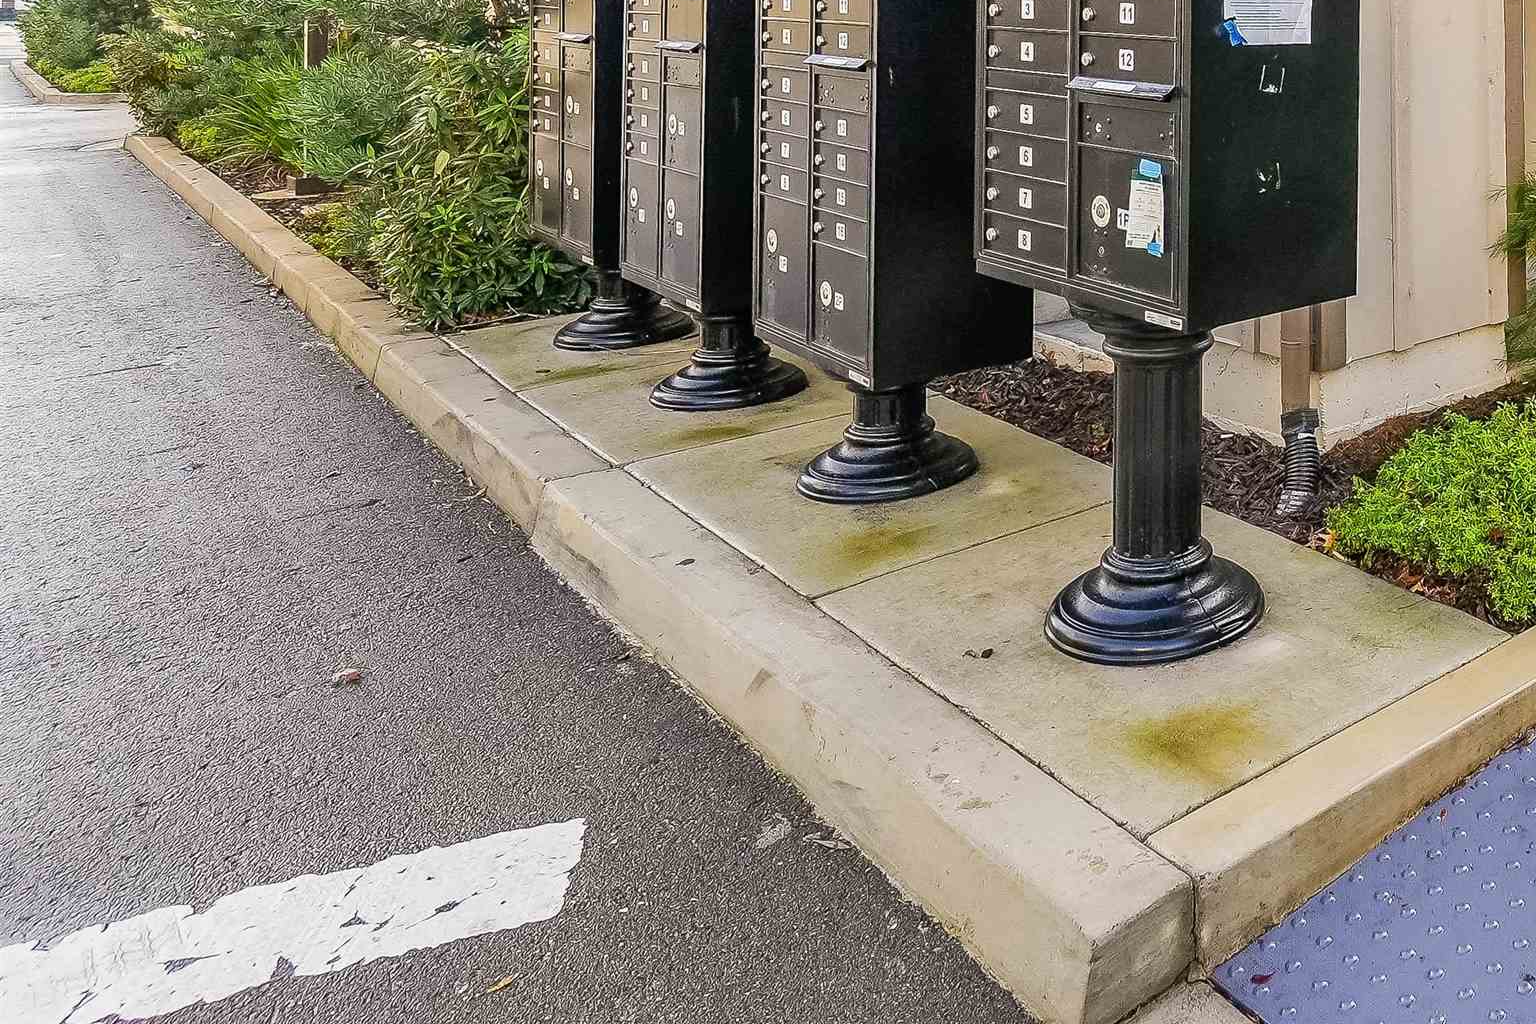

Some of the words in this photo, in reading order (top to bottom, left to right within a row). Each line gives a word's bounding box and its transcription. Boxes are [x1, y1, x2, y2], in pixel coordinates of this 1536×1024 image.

[1025, 2, 1031, 16] 3
[1121, 7, 1133, 21] 11
[1024, 45, 1030, 58] 4
[1120, 53, 1132, 67] 12
[1023, 107, 1029, 121] 5
[1023, 149, 1029, 163] 6
[1022, 191, 1028, 205] 7
[1022, 233, 1028, 247] 8
